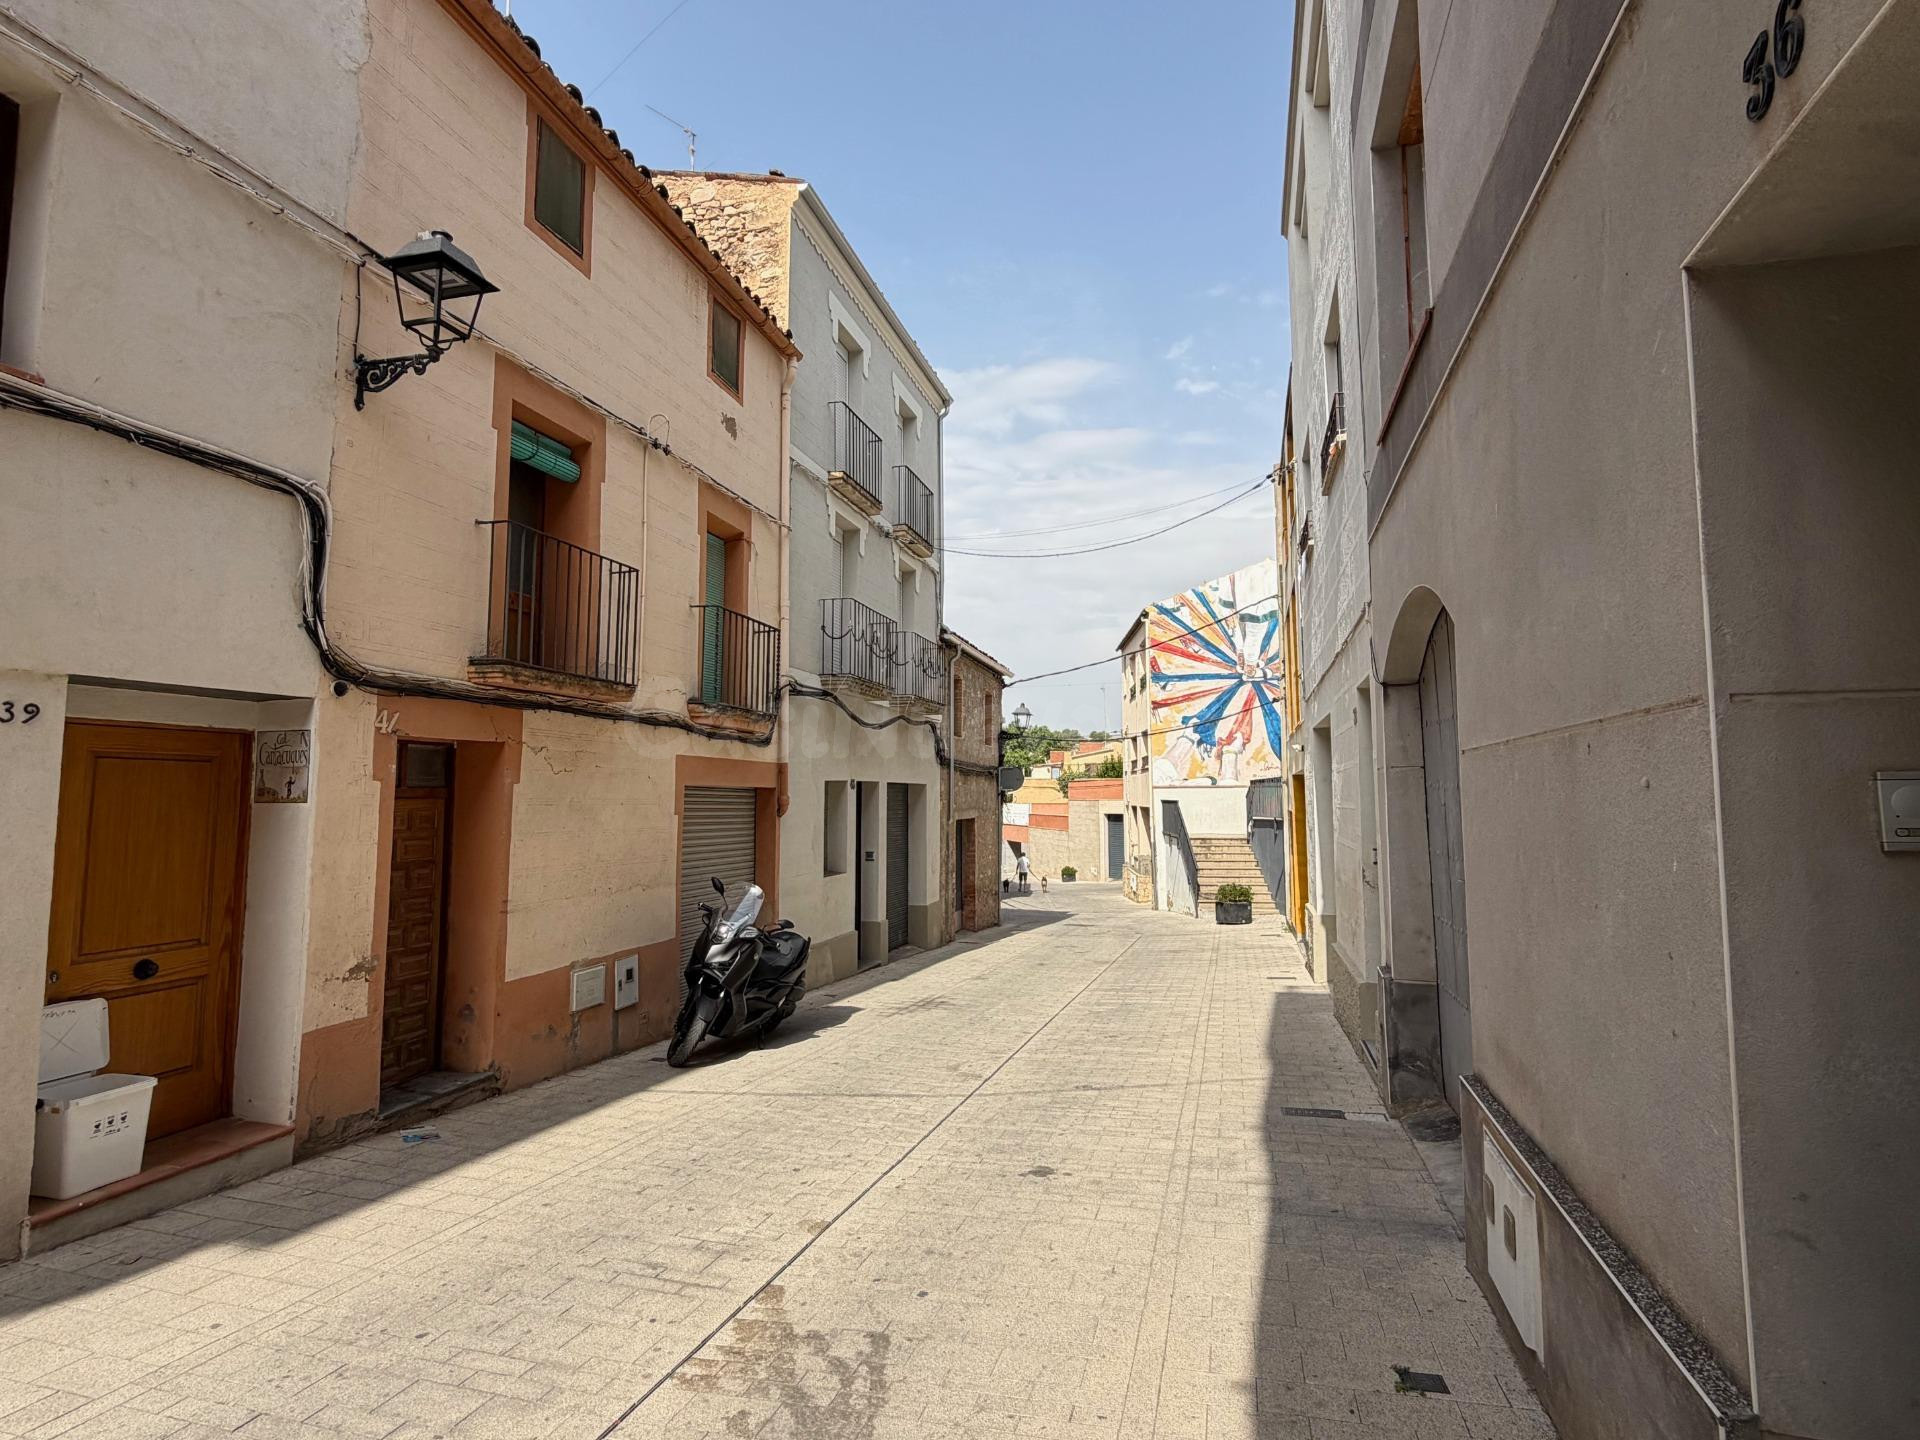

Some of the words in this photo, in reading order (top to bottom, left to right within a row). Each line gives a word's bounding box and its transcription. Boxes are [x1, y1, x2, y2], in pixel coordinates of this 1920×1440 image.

[1743, 0, 1805, 123] 36
[0, 701, 41, 724] 39
[375, 709, 400, 734] 41
